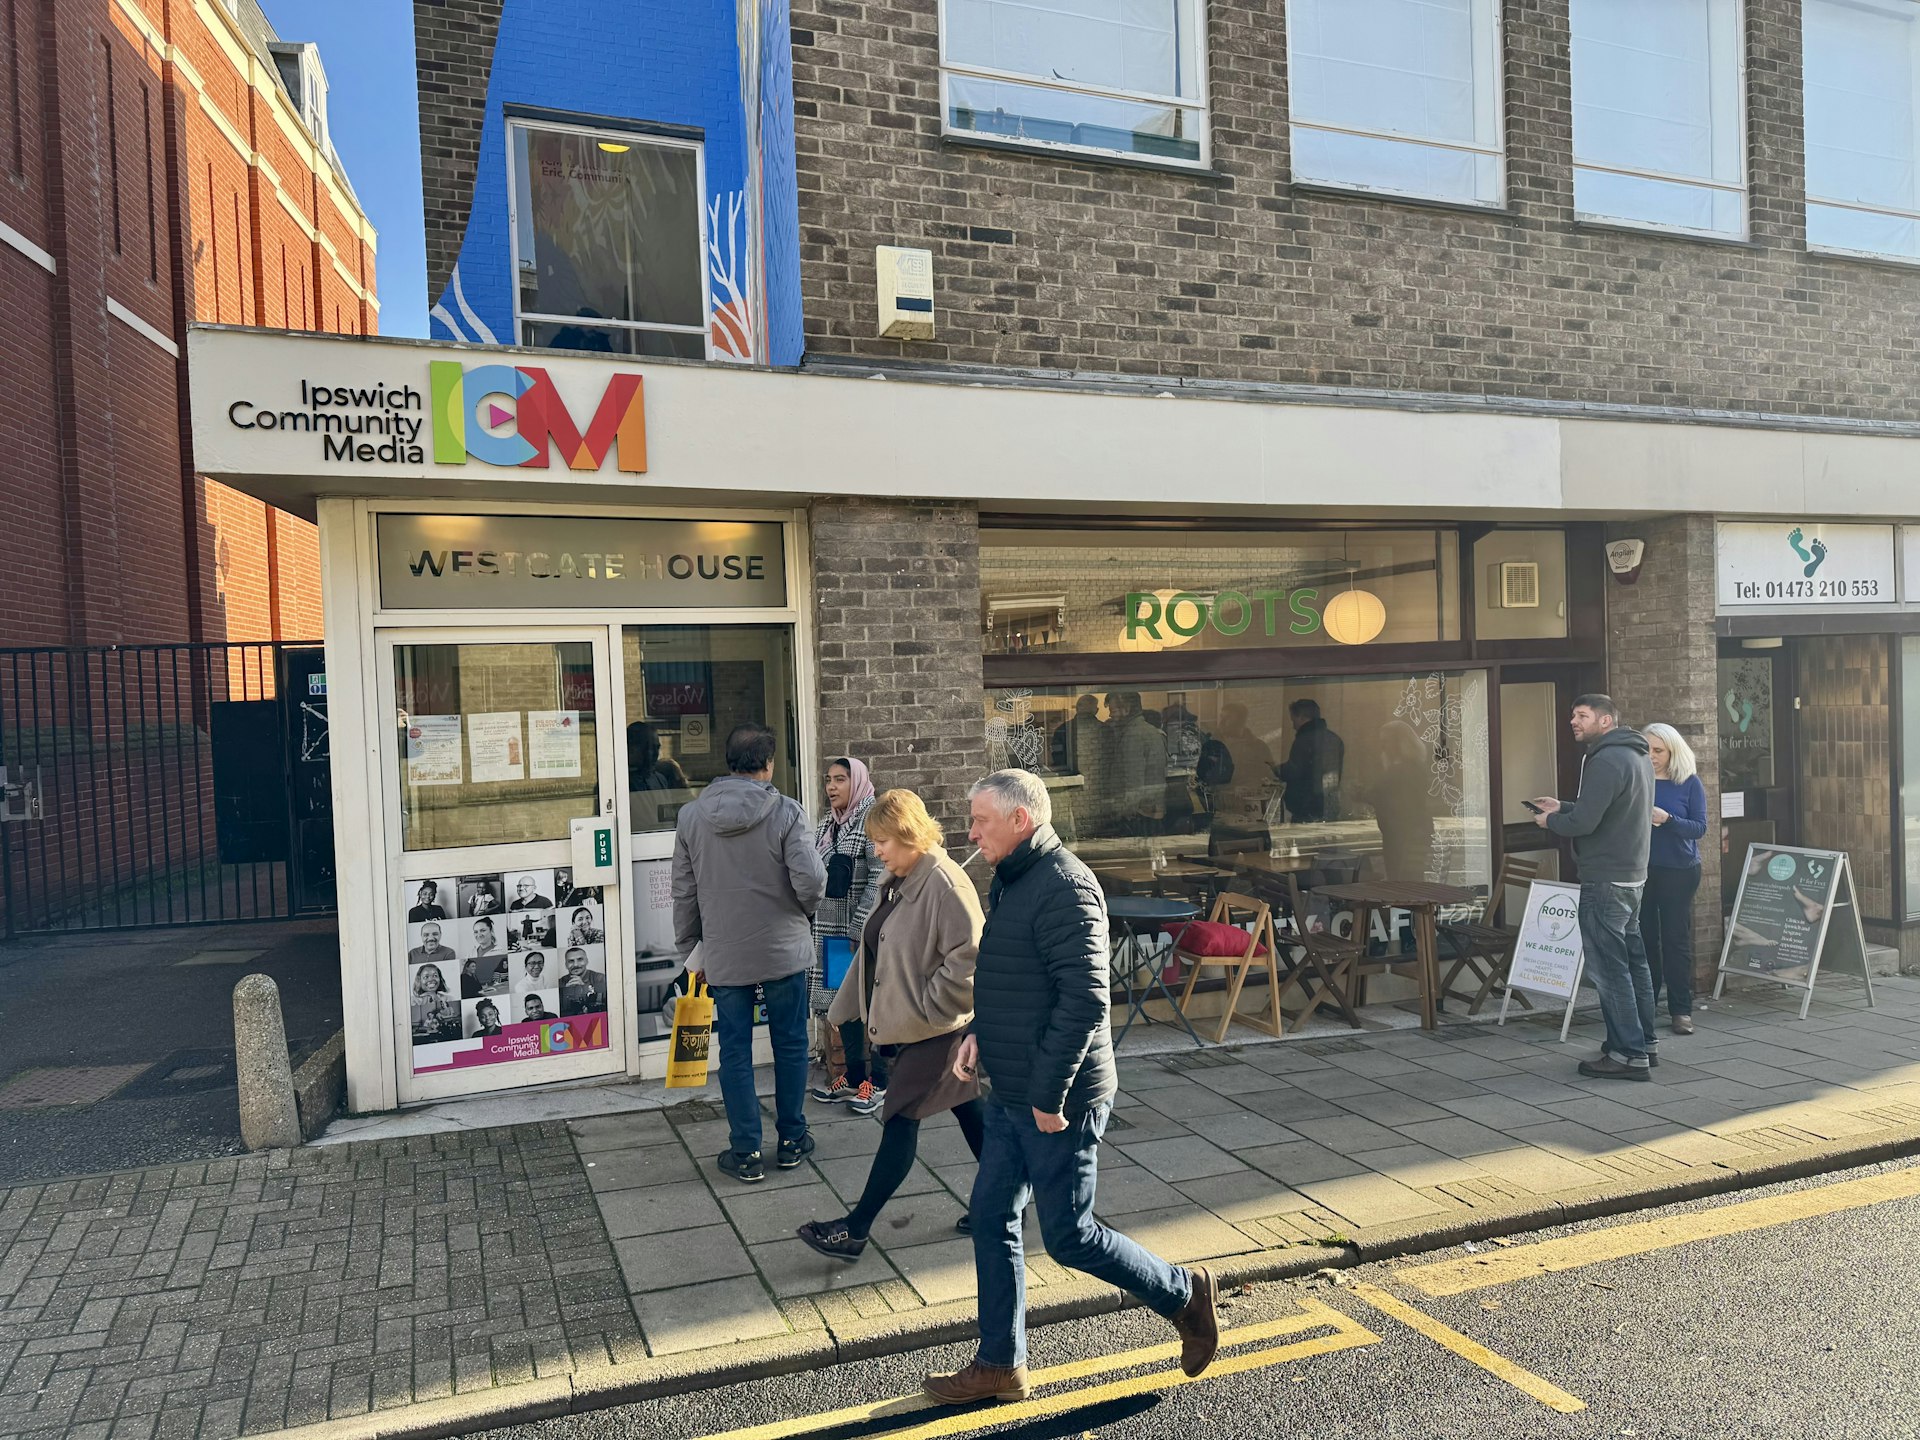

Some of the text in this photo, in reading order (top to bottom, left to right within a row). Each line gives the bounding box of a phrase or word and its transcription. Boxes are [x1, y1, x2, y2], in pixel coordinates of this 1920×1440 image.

[541, 166, 566, 179] Eric,
[300, 379, 422, 410] Ipswich
[229, 400, 423, 443] Community
[430, 360, 648, 473] ICM
[323, 433, 424, 464] Media
[407, 549, 766, 580] WESTGATE HOUSE
[1610, 549, 1635, 558] Anglian
[1734, 579, 1879, 599] Tel: 01473 210 553
[1125, 588, 1321, 640] ROOTS
[1729, 735, 1743, 749] for
[599, 833, 607, 861] PUSH
[1541, 905, 1576, 919] ROOTS
[1331, 905, 1416, 945] CAF
[1525, 941, 1575, 957] WE ARE OPEN
[491, 1041, 540, 1054] Community
[508, 1033, 539, 1045] Ipswich
[540, 1017, 603, 1054] ICM
[513, 1048, 540, 1058] Media
